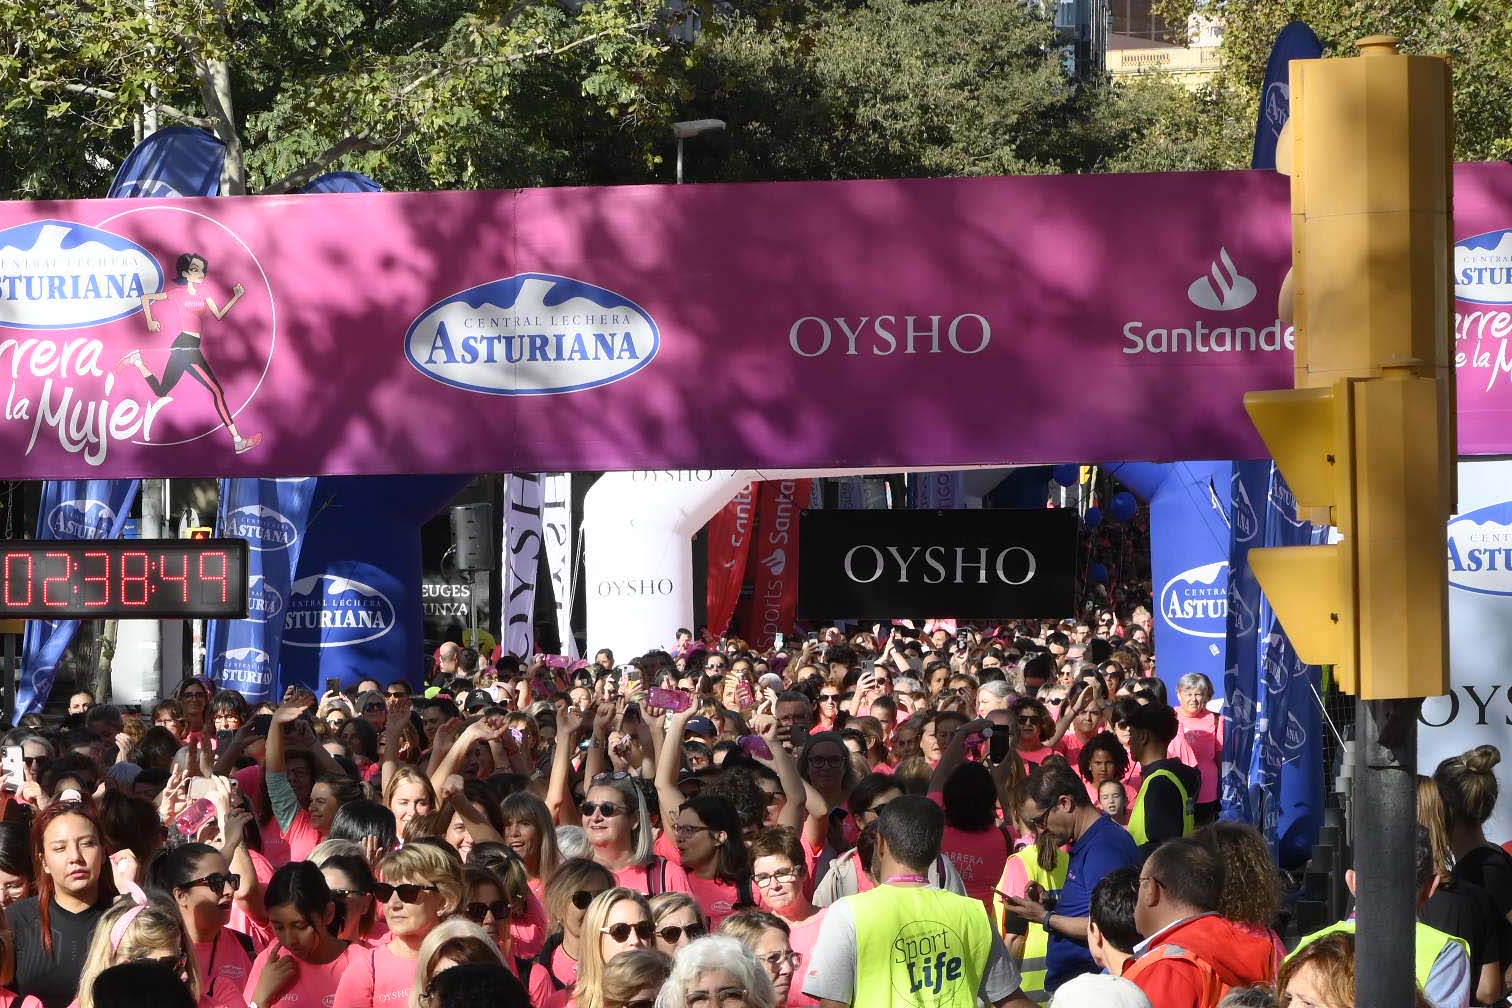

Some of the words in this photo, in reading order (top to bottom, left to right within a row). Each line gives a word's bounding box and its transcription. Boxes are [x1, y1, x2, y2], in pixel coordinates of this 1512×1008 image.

[1455, 266, 1512, 286] STU
[424, 320, 640, 365] ASTURIANA
[464, 316, 543, 329] CENTRAL
[550, 314, 632, 327] LECHERA
[789, 313, 991, 357] OYSHO
[4, 378, 30, 421] la
[24, 371, 174, 467] Mujer
[4, 551, 229, 606] 02:38:49
[844, 544, 1038, 586] OYSHO
[597, 578, 674, 598] OYSHO
[895, 928, 951, 964] Sport
[907, 952, 962, 995] Life
